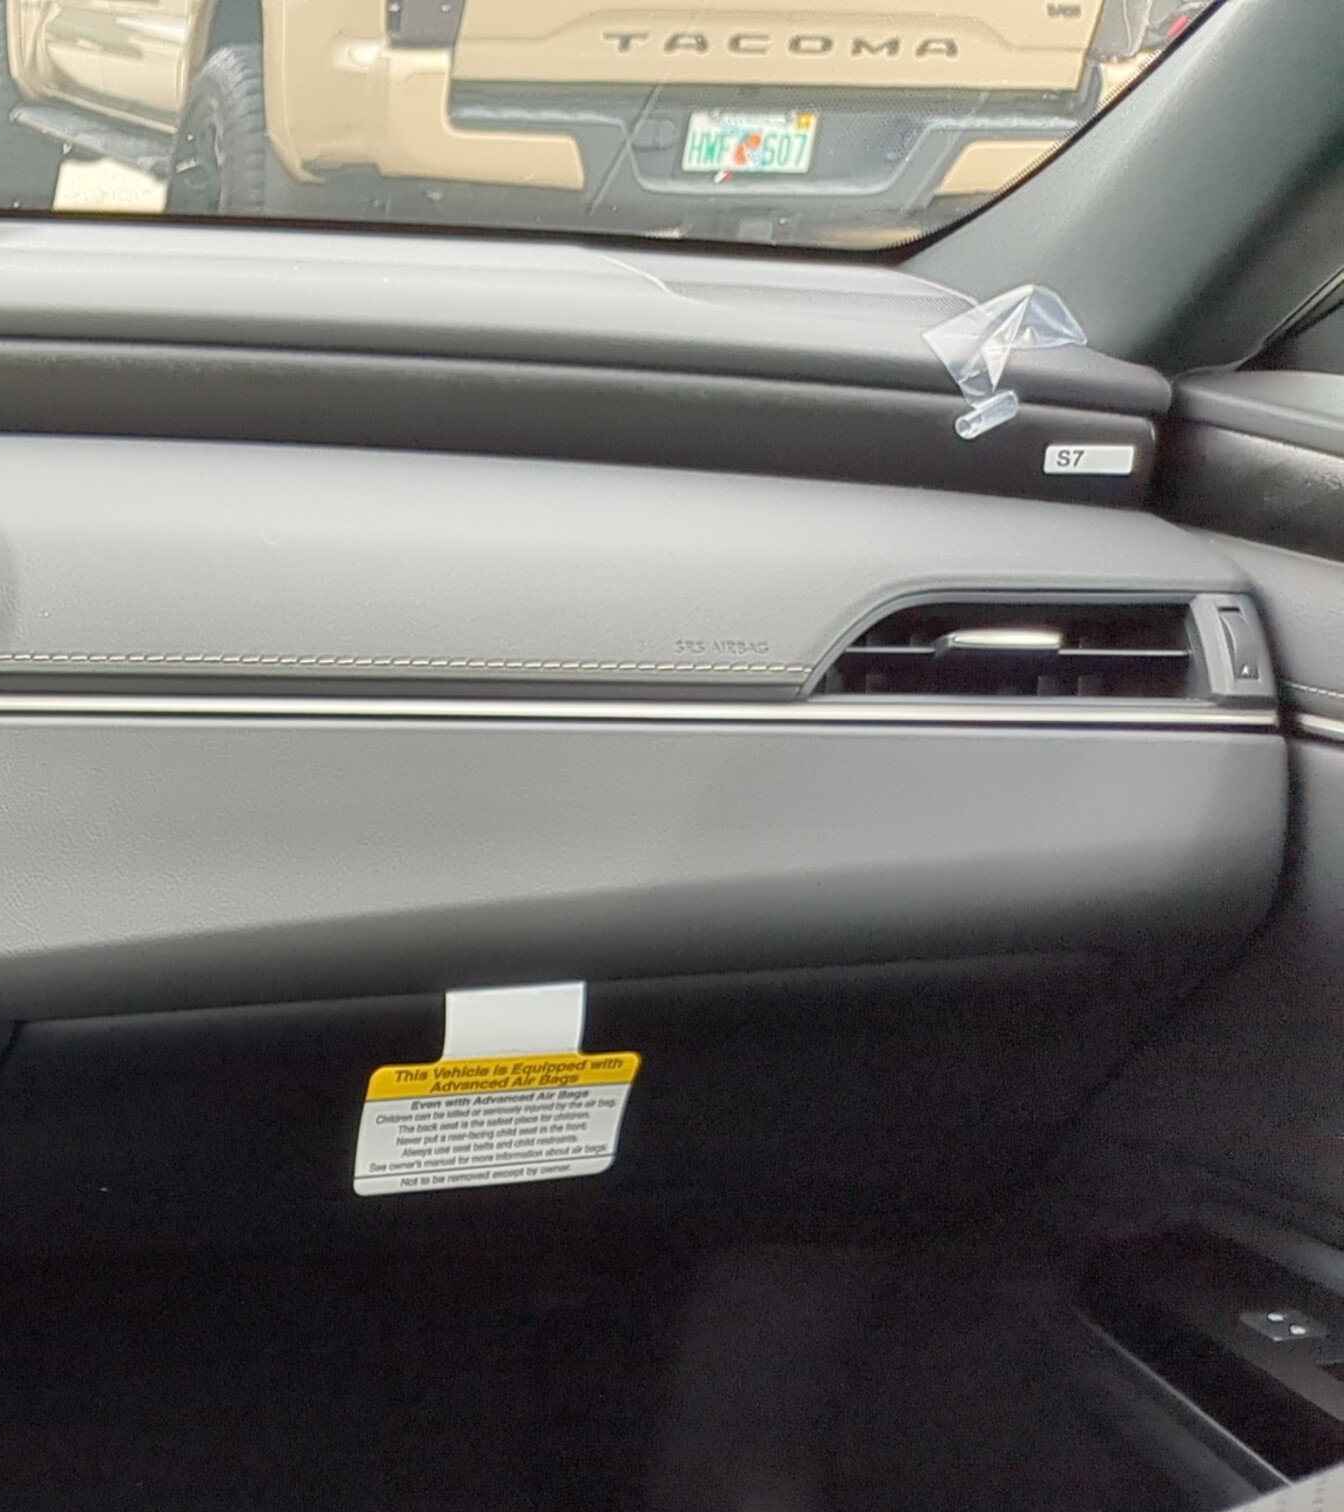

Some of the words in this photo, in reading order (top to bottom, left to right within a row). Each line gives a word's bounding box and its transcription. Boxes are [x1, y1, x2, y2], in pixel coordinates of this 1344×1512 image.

[603, 32, 959, 57] TACOMA
[1056, 449, 1085, 468] S7
[395, 1069, 428, 1083] This
[433, 1066, 489, 1079] Vehicle
[493, 1064, 507, 1075] is
[511, 1060, 586, 1078] Equipped
[590, 1058, 623, 1069] with
[429, 1077, 510, 1093] Advanced
[511, 1077, 536, 1089] Air
[538, 1074, 579, 1087] Bags
[411, 1101, 442, 1111] Even
[445, 1097, 470, 1107] with
[473, 1092, 534, 1106] Advanced
[536, 1091, 555, 1101] Air
[557, 1090, 589, 1101] Bags
[376, 1114, 413, 1125] Children
[414, 1112, 431, 1120] can
[433, 1111, 445, 1119] be
[398, 1125, 415, 1134] The
[416, 1123, 438, 1133] back
[369, 1163, 387, 1173] See
[400, 1178, 418, 1187] Not
[420, 1177, 430, 1185] to
[432, 1175, 445, 1184] be
